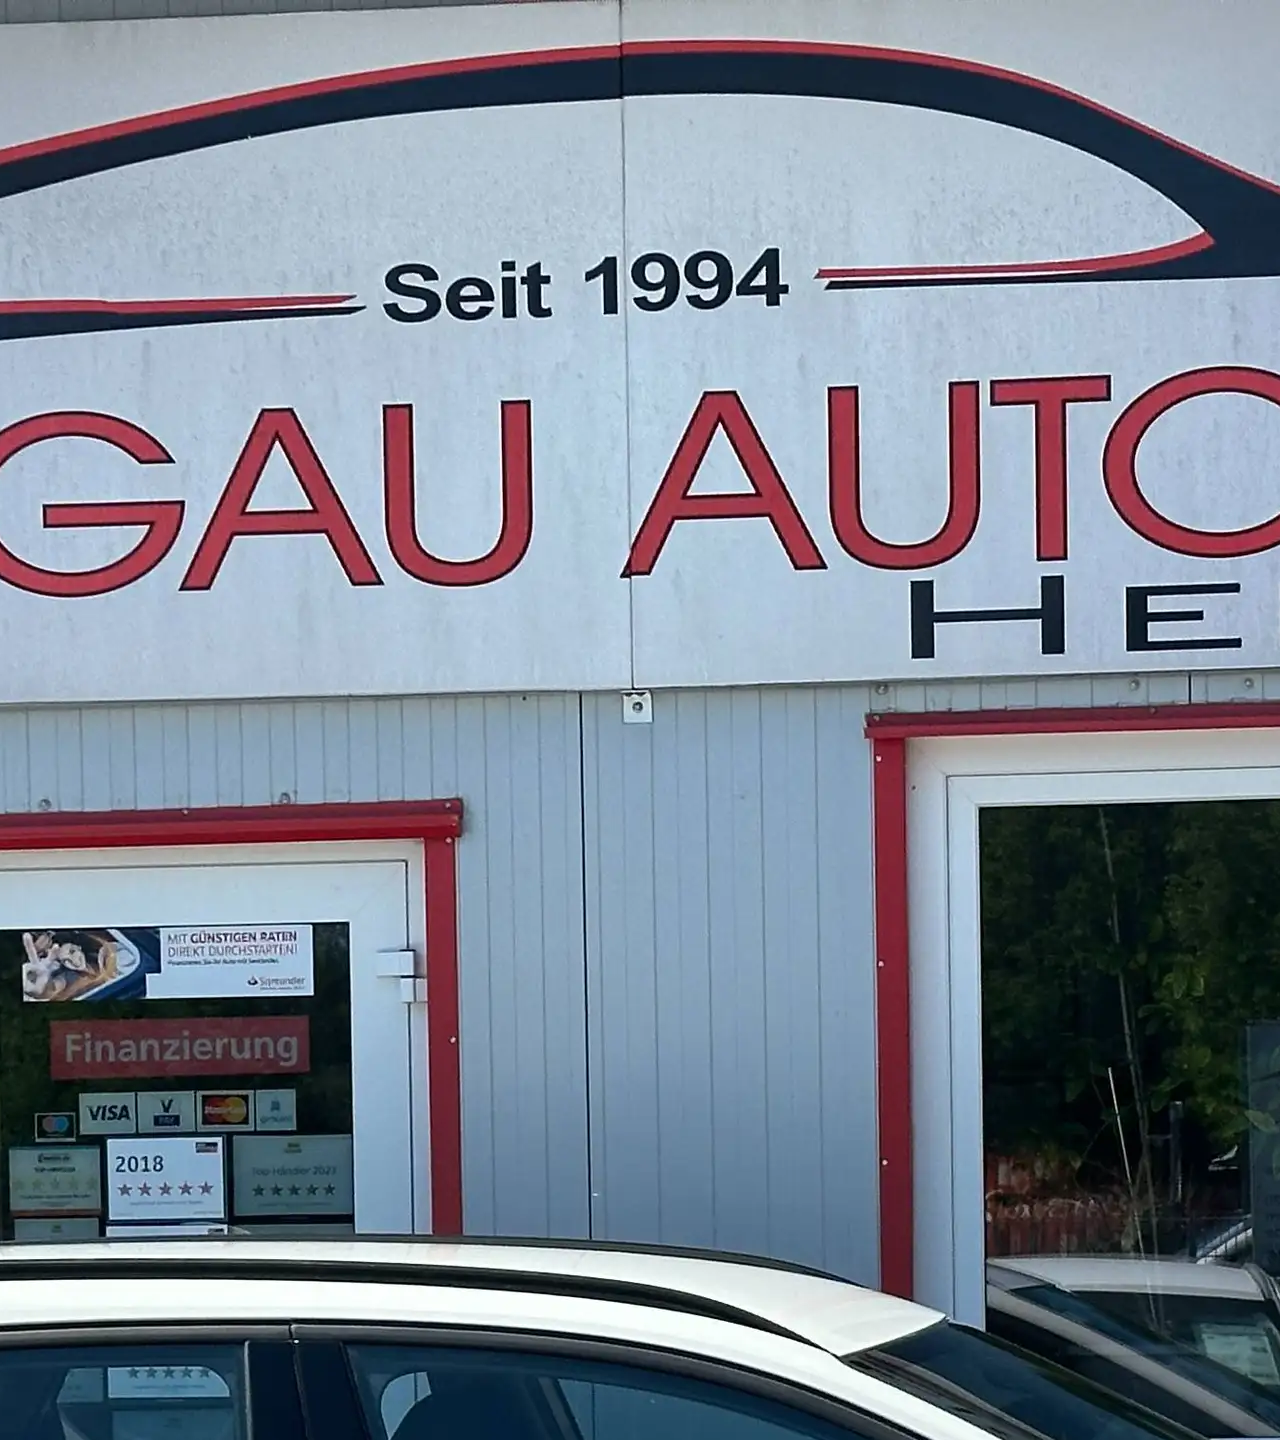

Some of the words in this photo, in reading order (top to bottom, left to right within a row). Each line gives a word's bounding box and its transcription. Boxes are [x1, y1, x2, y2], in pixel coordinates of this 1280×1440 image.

[383, 261, 553, 323] Seit
[584, 247, 790, 315] 1994
[167, 934, 188, 944] MIT
[191, 930, 256, 943] GÜNSTIGEN
[260, 931, 297, 942] RATEN
[167, 946, 205, 957] DIREKT
[65, 1030, 299, 1067] Finanzierung
[86, 1104, 131, 1121] VISA
[115, 1155, 164, 1173] 2018
